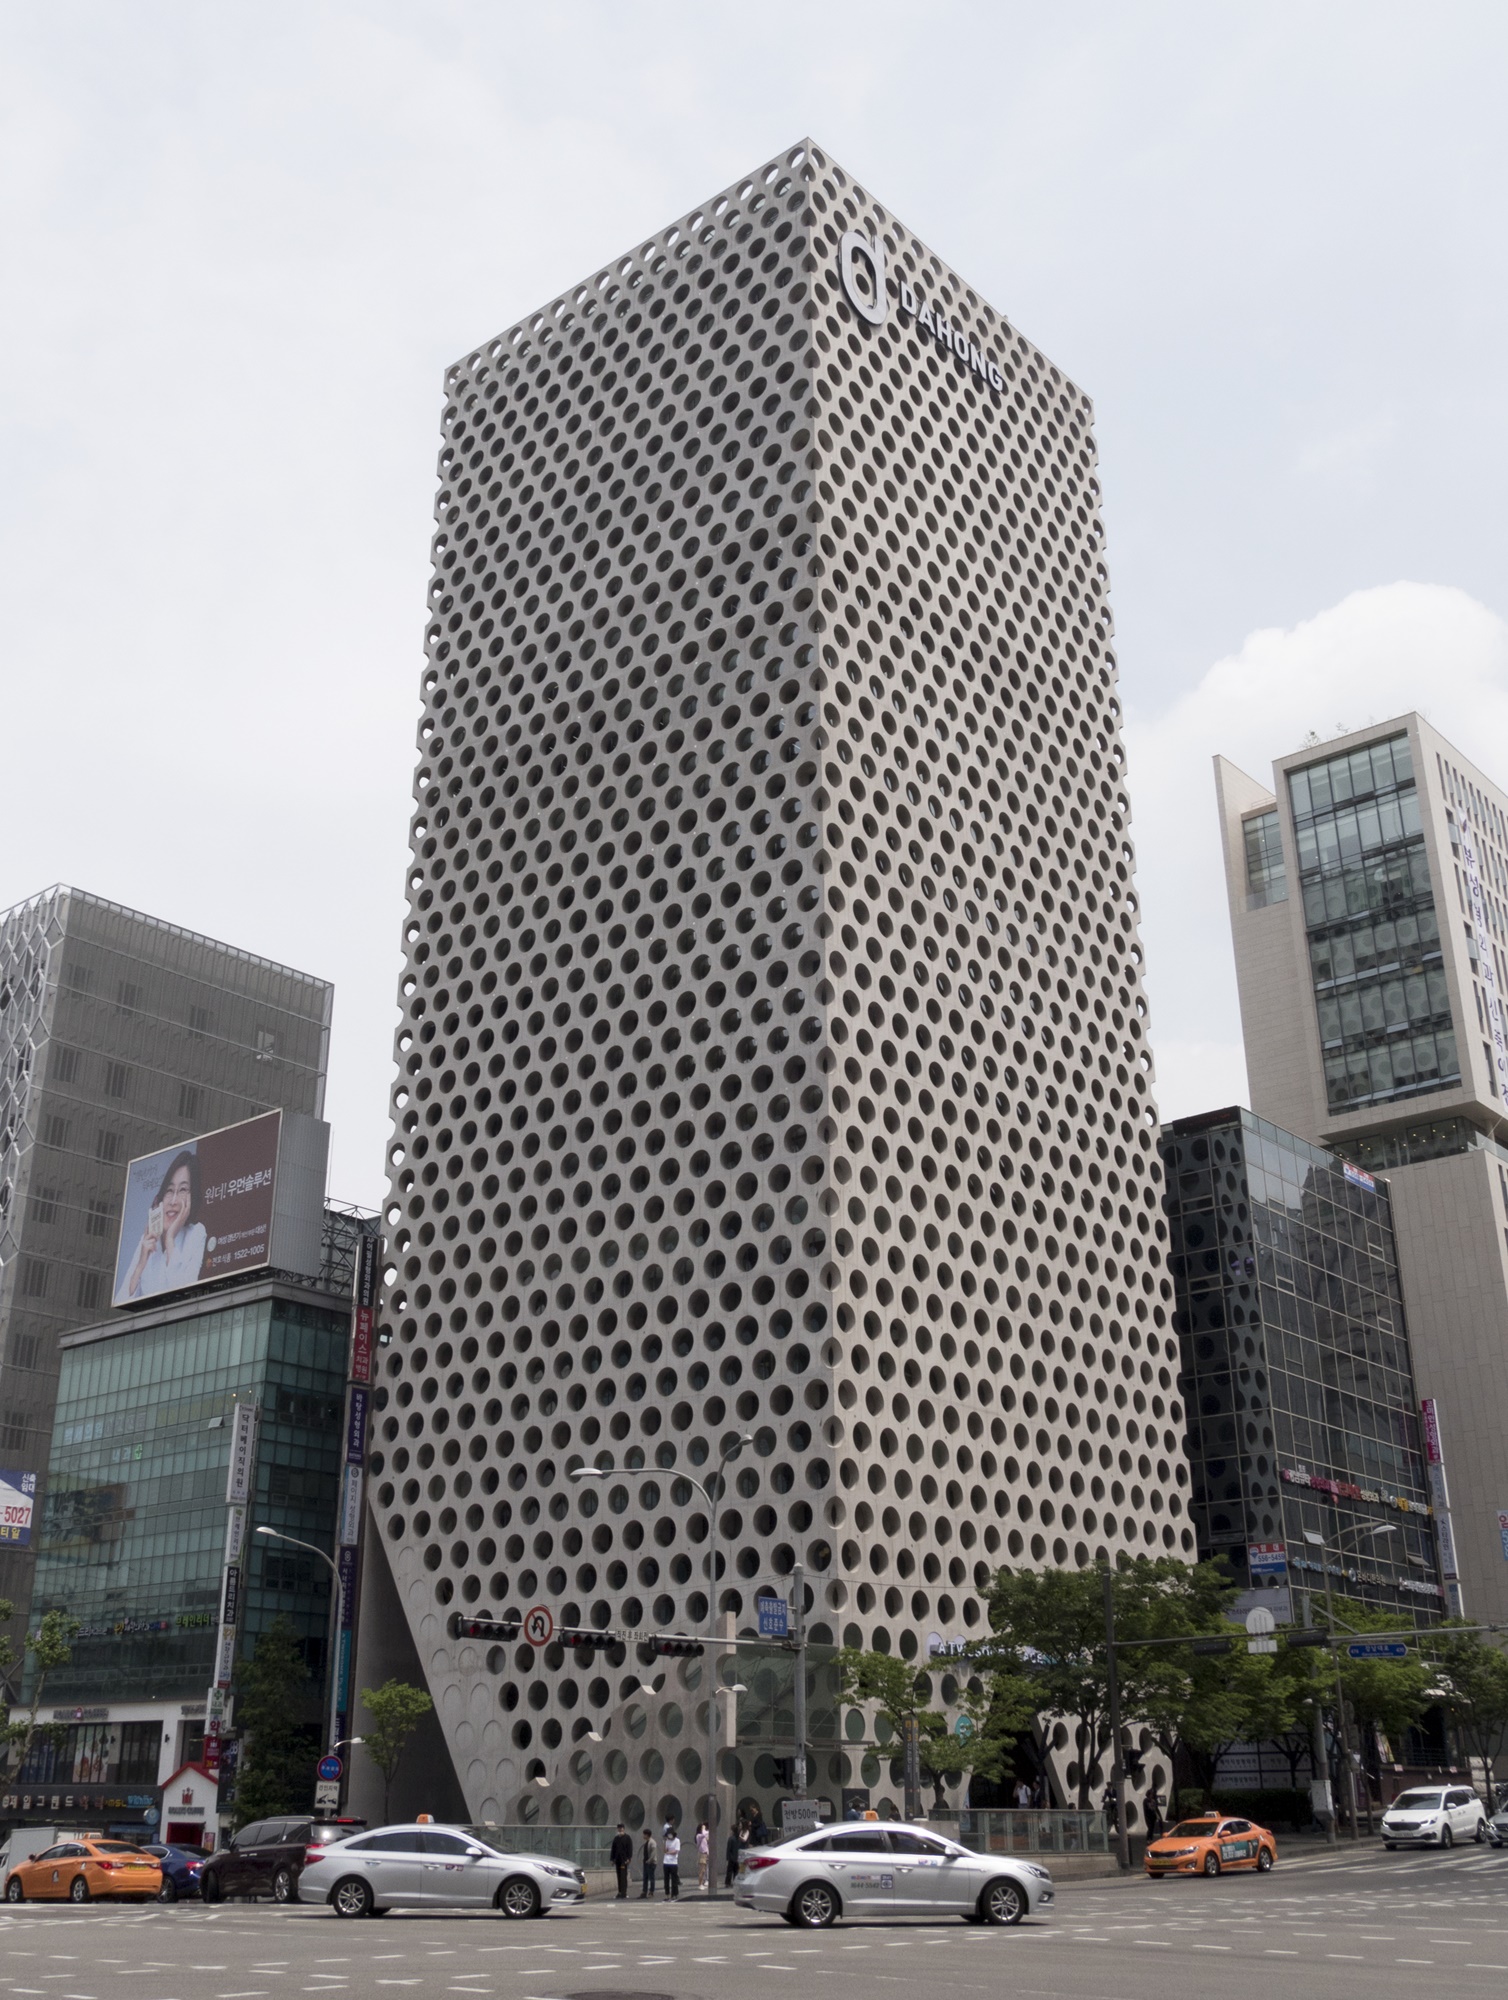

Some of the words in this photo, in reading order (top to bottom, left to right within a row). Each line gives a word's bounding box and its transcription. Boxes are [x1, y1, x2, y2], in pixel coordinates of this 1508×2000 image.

[899, 280, 1004, 394] DAHONG
[204, 1182, 227, 1205] 원더!
[227, 1168, 273, 1197] 우먼솔루션
[234, 1243, 265, 1260] 1522-1005
[357, 1310, 370, 1354] 뉴페이스
[236, 1414, 250, 1488] 닥터베이직의원
[21, 1483, 36, 1493] 임대
[226, 1568, 237, 1616] 아름드리치과
[175, 1613, 211, 1628] 브레인리더
[763, 1616, 784, 1632] 신호준수
[318, 1784, 338, 1792] 견인지역
